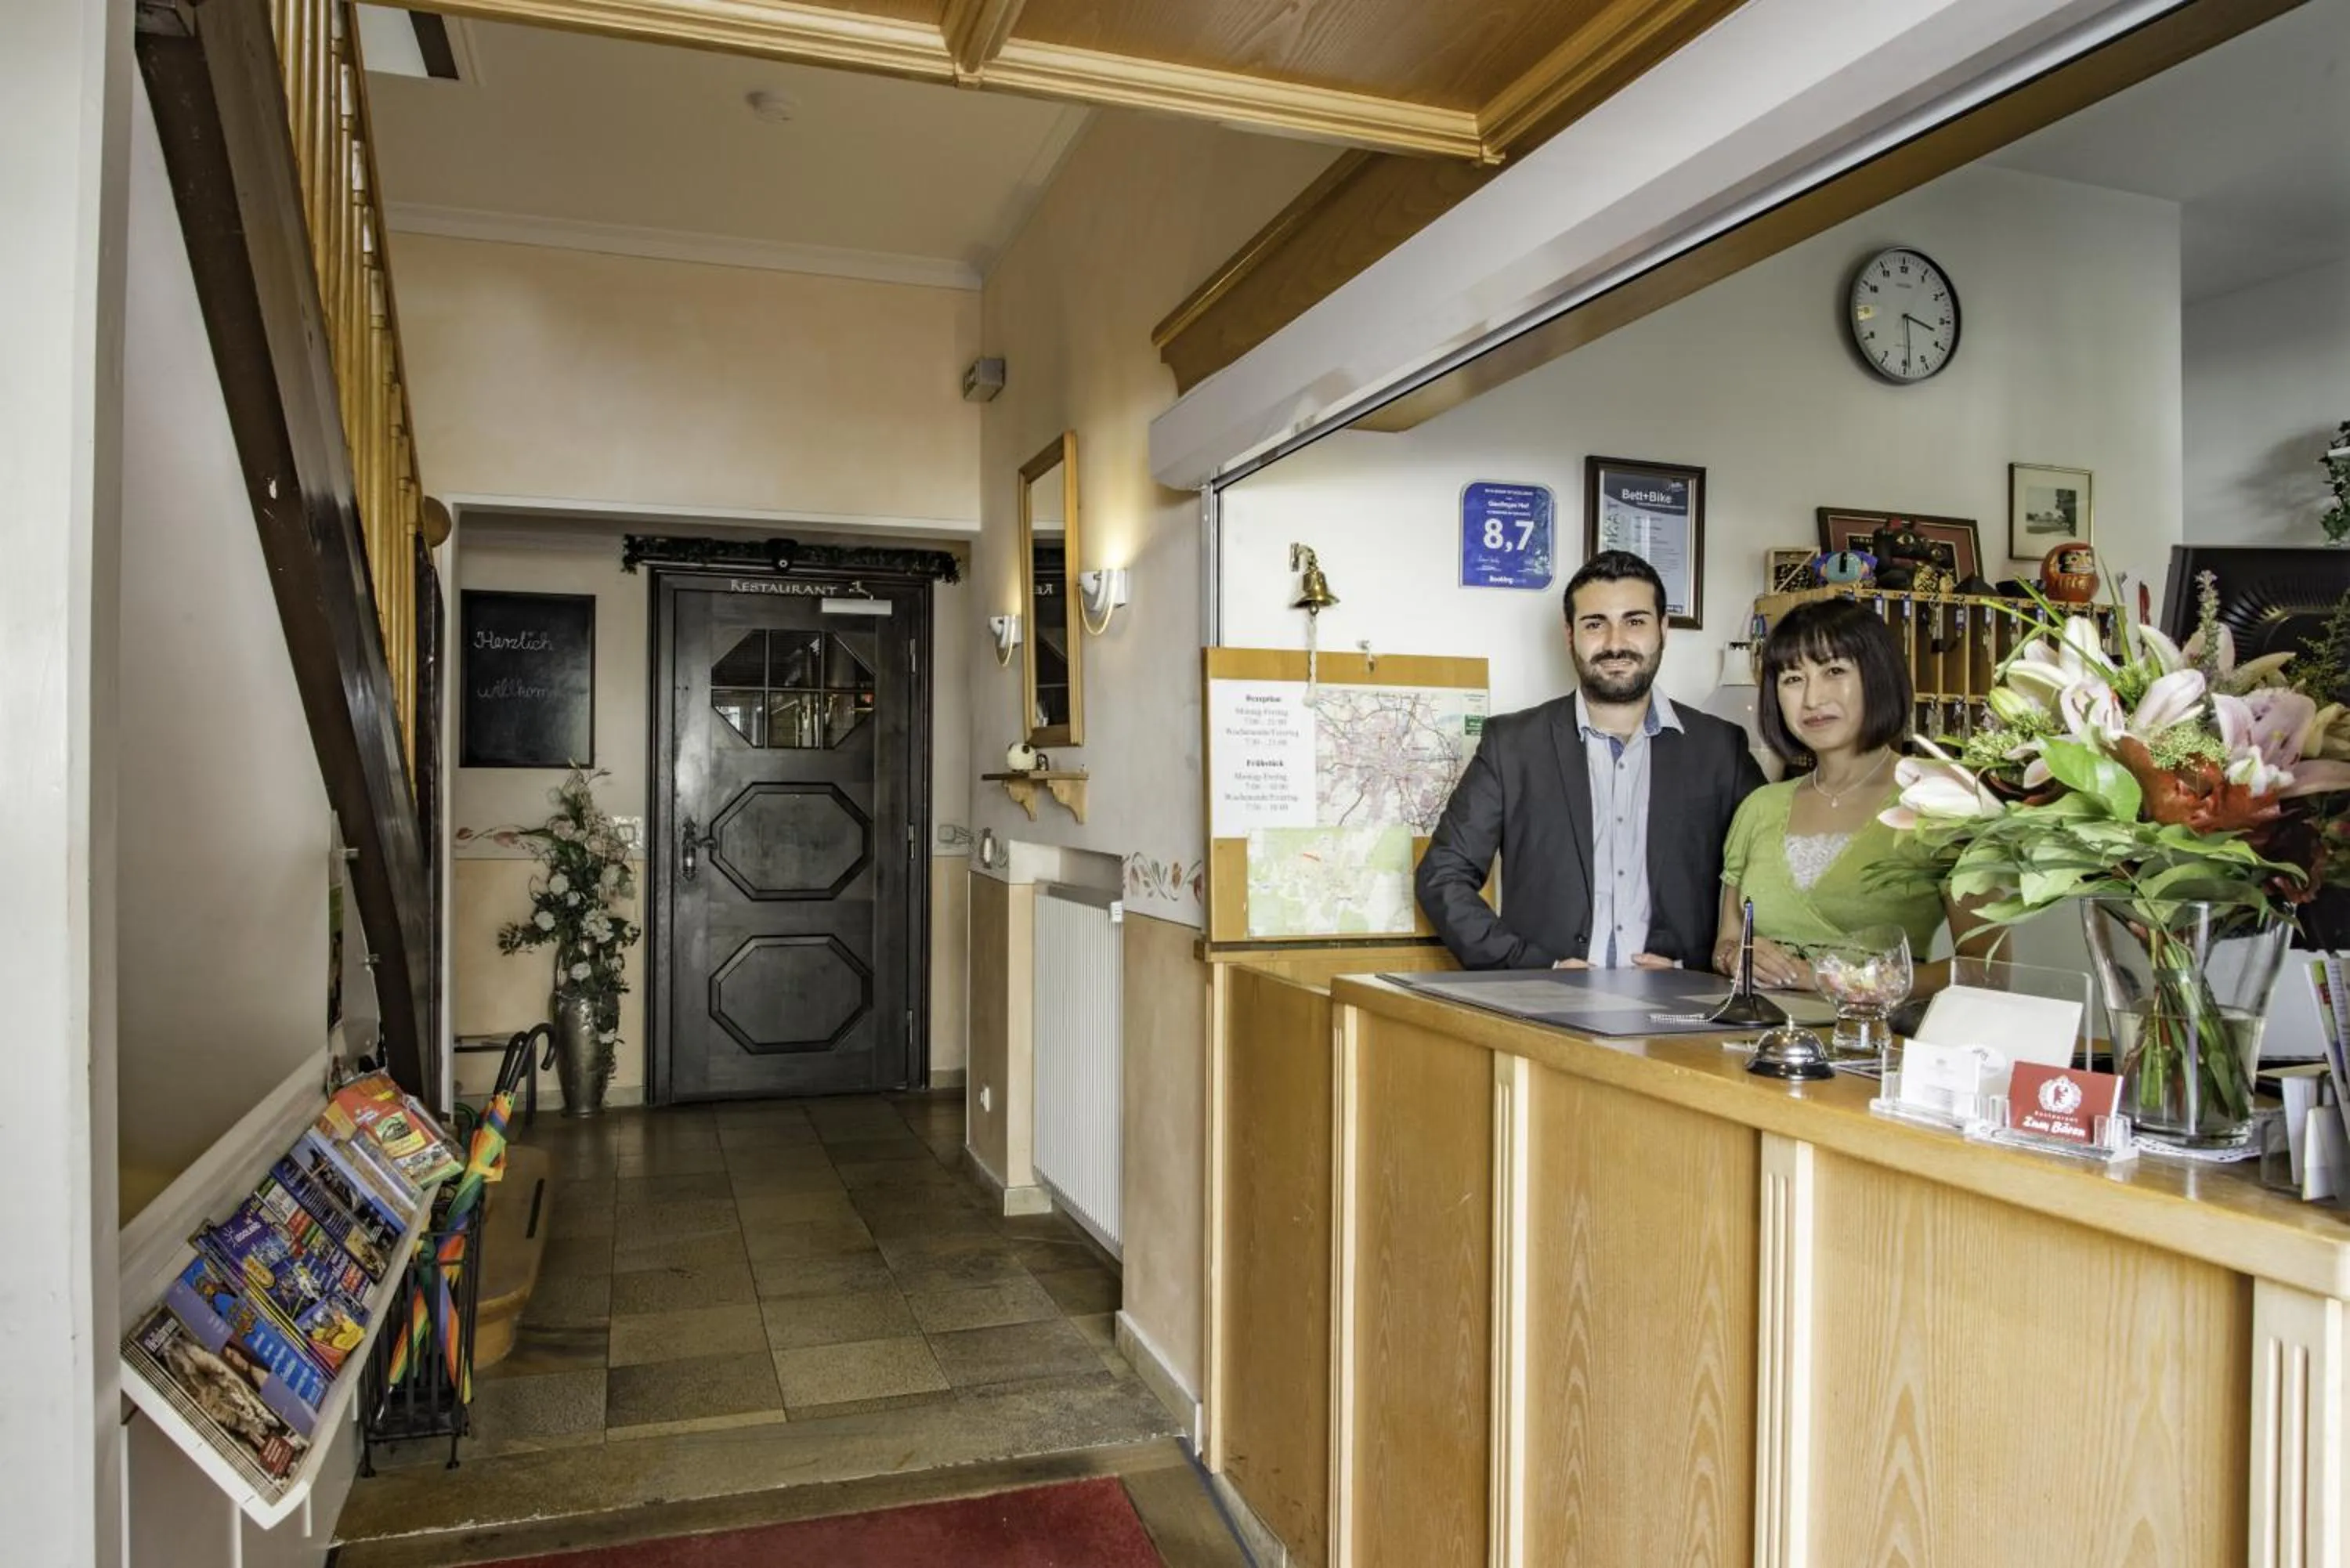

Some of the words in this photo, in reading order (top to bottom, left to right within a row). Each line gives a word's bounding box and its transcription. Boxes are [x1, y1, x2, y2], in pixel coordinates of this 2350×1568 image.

[1622, 488, 1672, 504] Bett+Bike
[1483, 518, 1535, 552] 8,7
[730, 579, 837, 595] RESTAURANT
[473, 630, 553, 650] Herzlich
[476, 677, 561, 699] willkom
